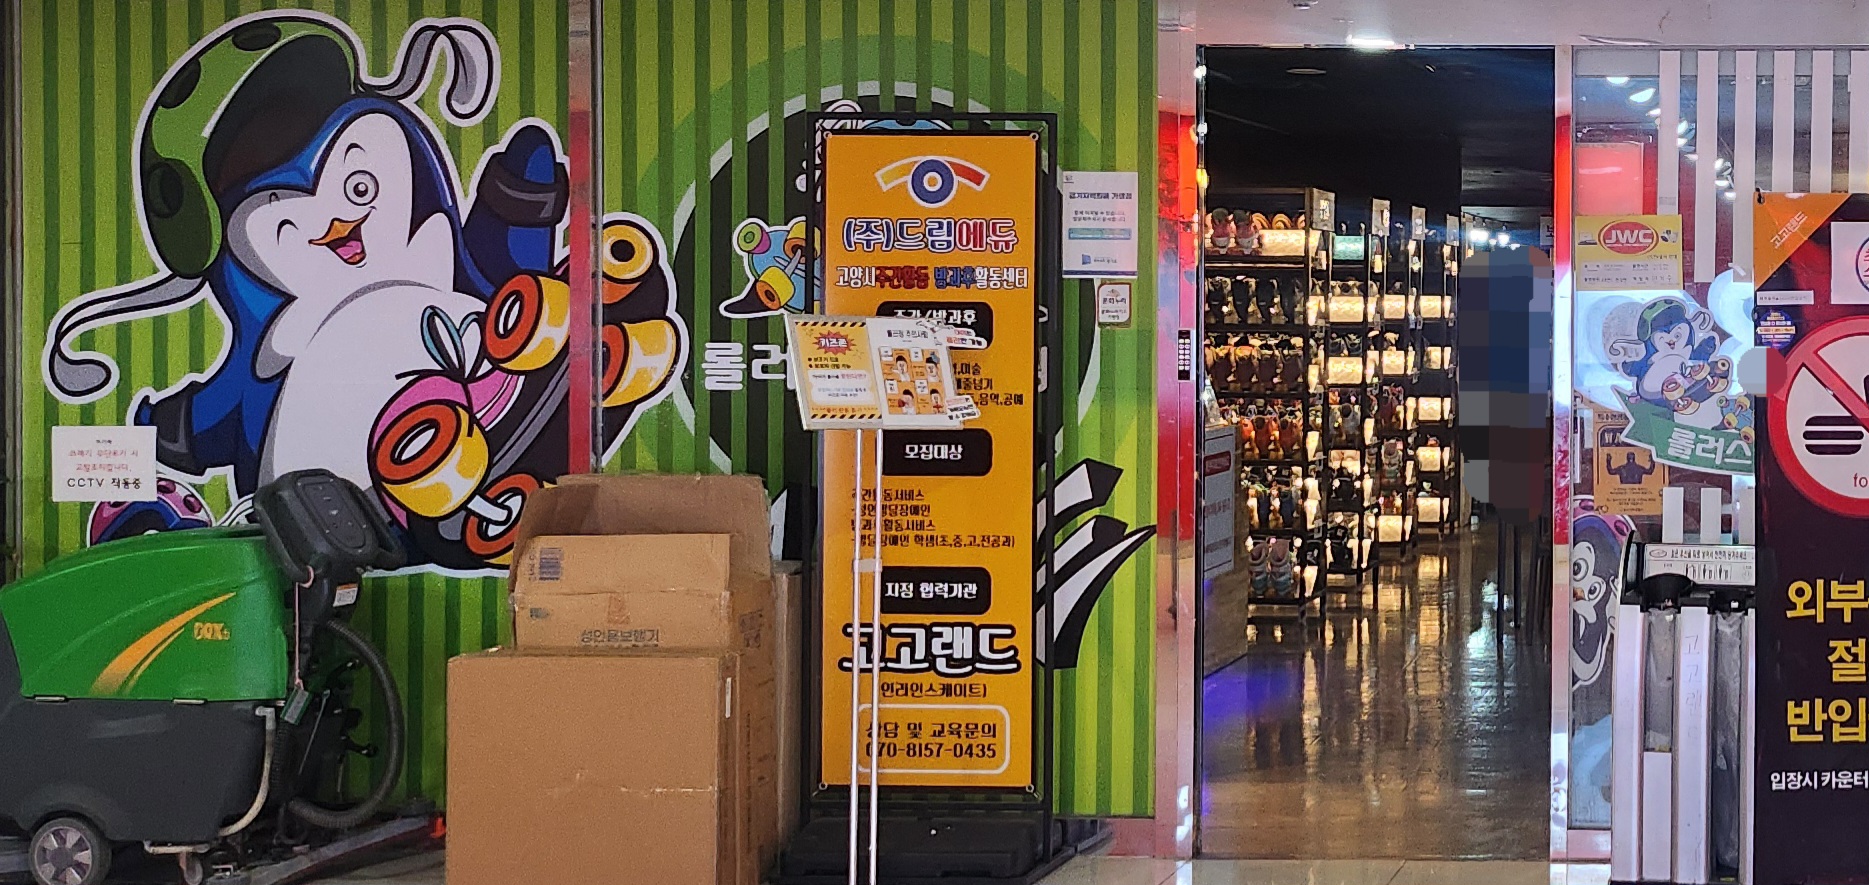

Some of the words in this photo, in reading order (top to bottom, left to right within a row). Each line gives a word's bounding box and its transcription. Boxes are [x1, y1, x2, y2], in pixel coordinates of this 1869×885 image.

[842, 217, 1019, 253] (주)드림에듀
[1605, 229, 1654, 244] JWC
[1769, 210, 1808, 249] 고고랜드
[836, 266, 930, 289] 고양시주간활동
[933, 266, 1029, 289] 방과후활동센터
[904, 444, 963, 461] 모집대상
[66, 477, 105, 488] CCTV
[111, 477, 142, 490] 작동중
[885, 582, 914, 598] 지정
[919, 582, 978, 599] 협력기관
[581, 629, 660, 643] 성인용보행기
[840, 624, 1019, 677] 고고랜드
[907, 722, 923, 739] 및
[930, 721, 997, 739] 교육문의
[865, 742, 997, 759] 070-8157-0435
[1770, 770, 1819, 791] 입장시
